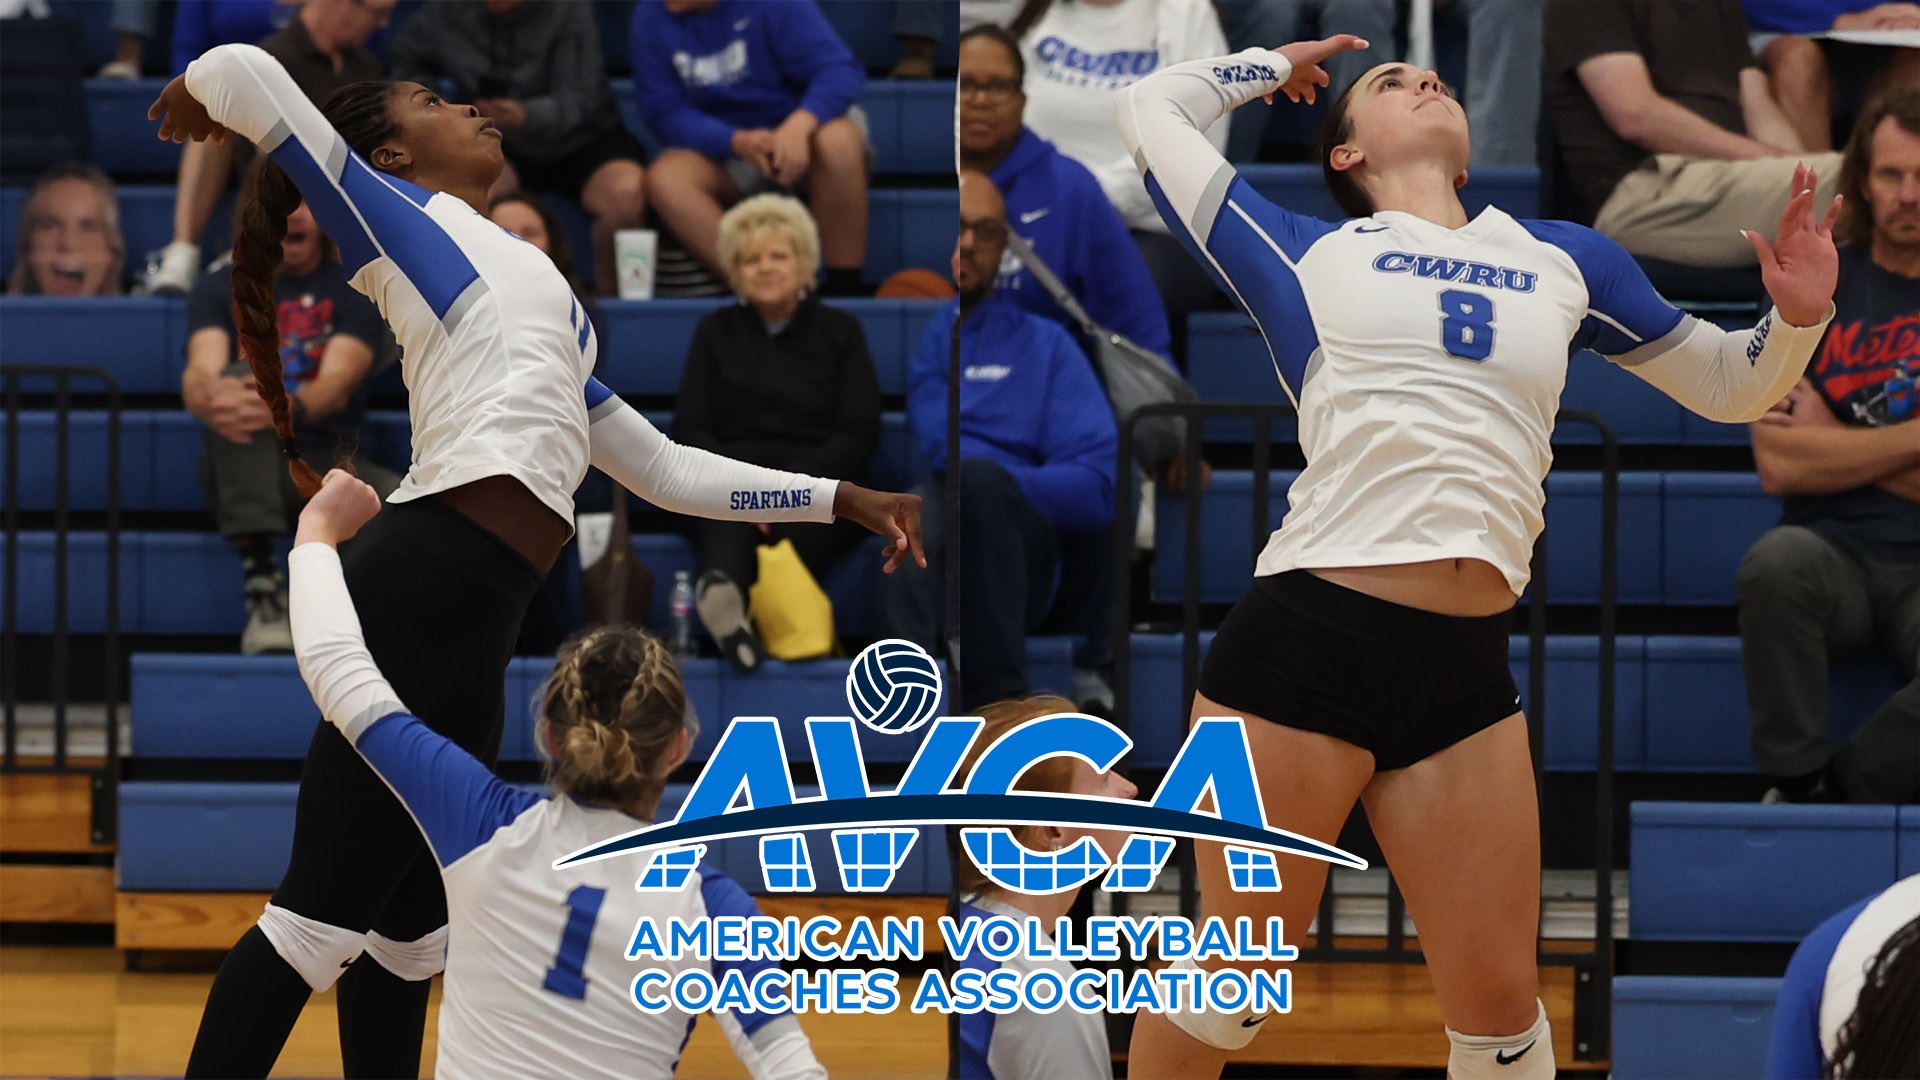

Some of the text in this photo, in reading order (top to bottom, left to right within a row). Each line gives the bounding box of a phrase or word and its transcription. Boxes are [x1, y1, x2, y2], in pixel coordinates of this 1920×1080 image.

[1372, 251, 1538, 293] CWRU
[1437, 287, 1497, 364] 8
[729, 488, 811, 510] SPARTANS
[542, 884, 607, 1001] 1
